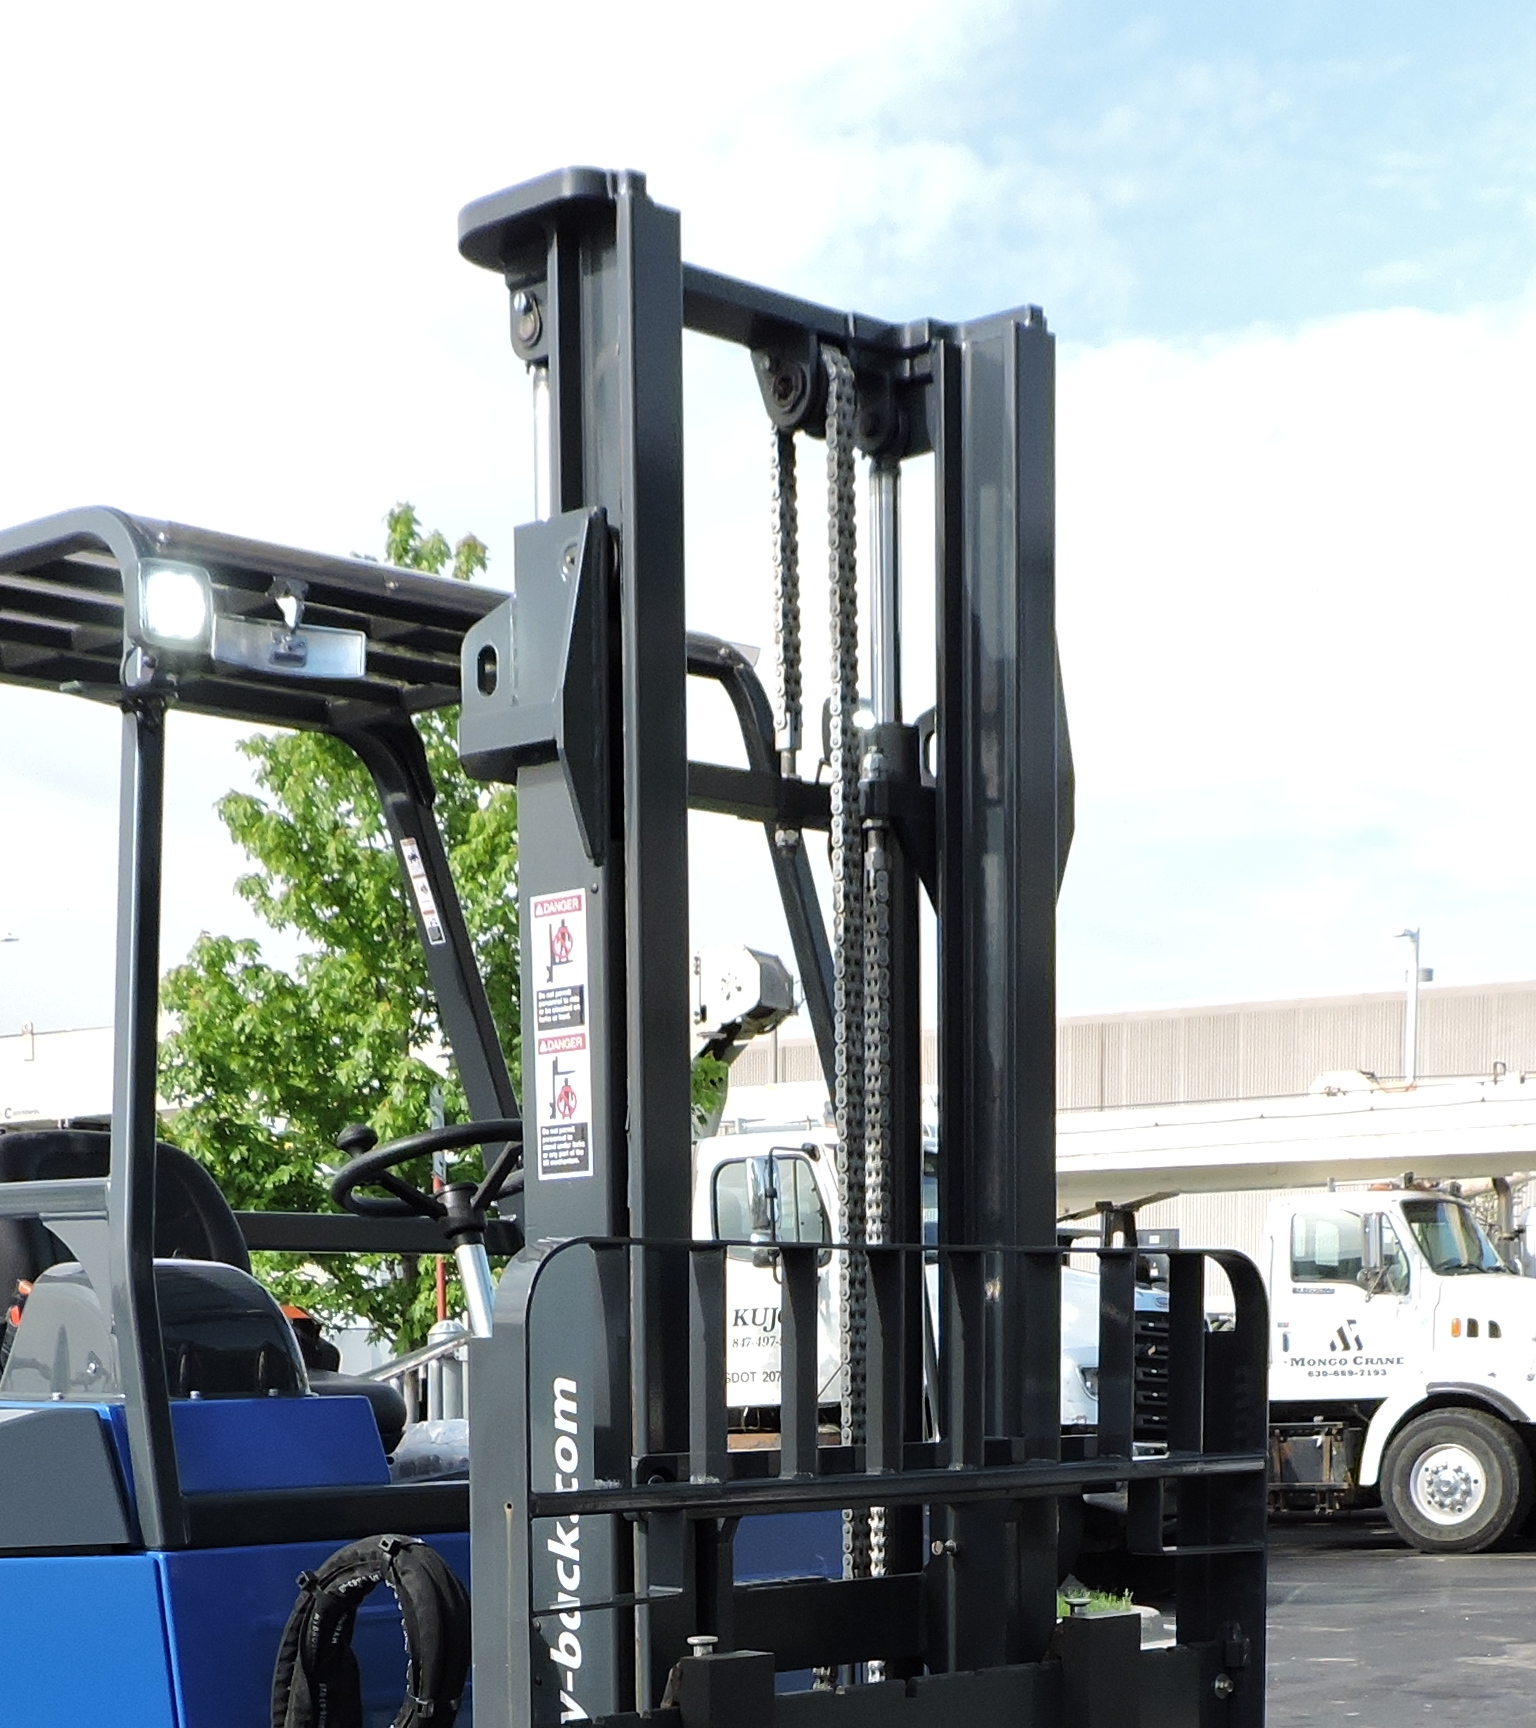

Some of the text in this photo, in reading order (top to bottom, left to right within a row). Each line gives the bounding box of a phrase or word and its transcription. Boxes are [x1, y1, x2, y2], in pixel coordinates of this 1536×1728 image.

[544, 897, 579, 914] DANGER
[547, 1036, 583, 1050] DANGER
[732, 1307, 782, 1333] KUJ
